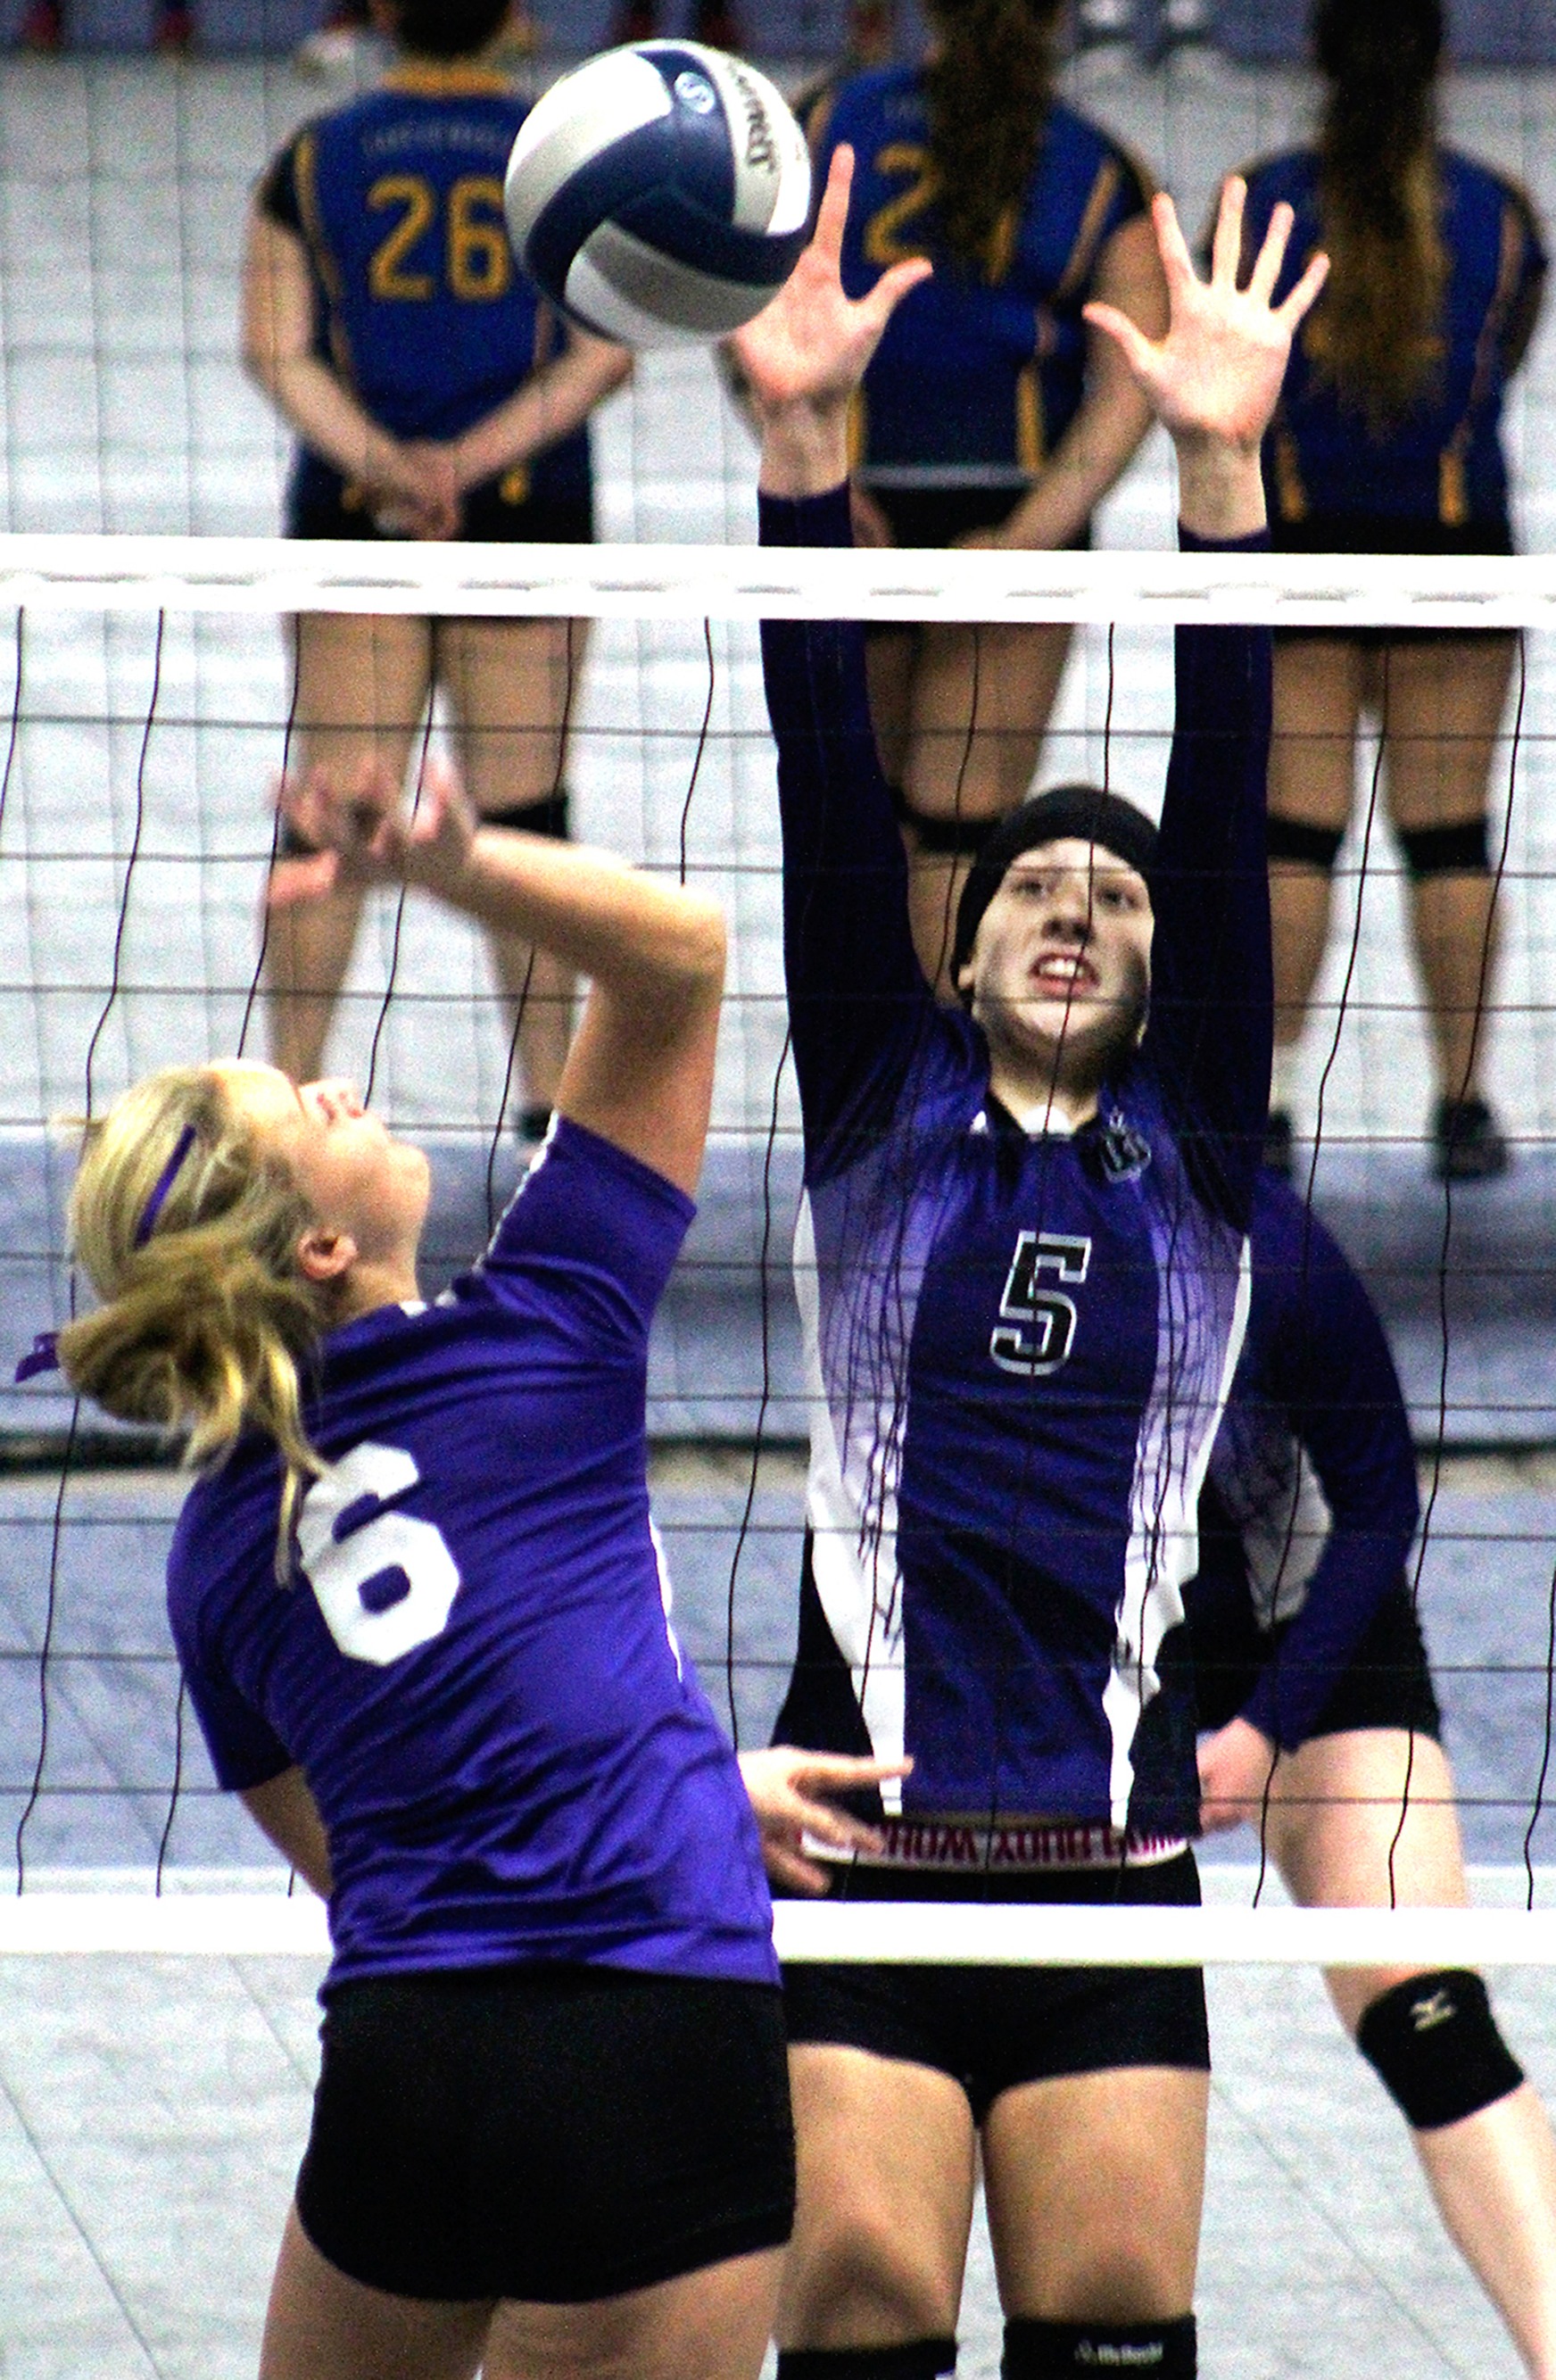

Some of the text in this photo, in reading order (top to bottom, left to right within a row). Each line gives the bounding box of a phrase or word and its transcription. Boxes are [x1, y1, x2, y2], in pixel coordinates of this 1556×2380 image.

[365, 176, 510, 301] 26
[989, 1230, 1092, 1375] 5
[295, 1440, 460, 1667] 6
